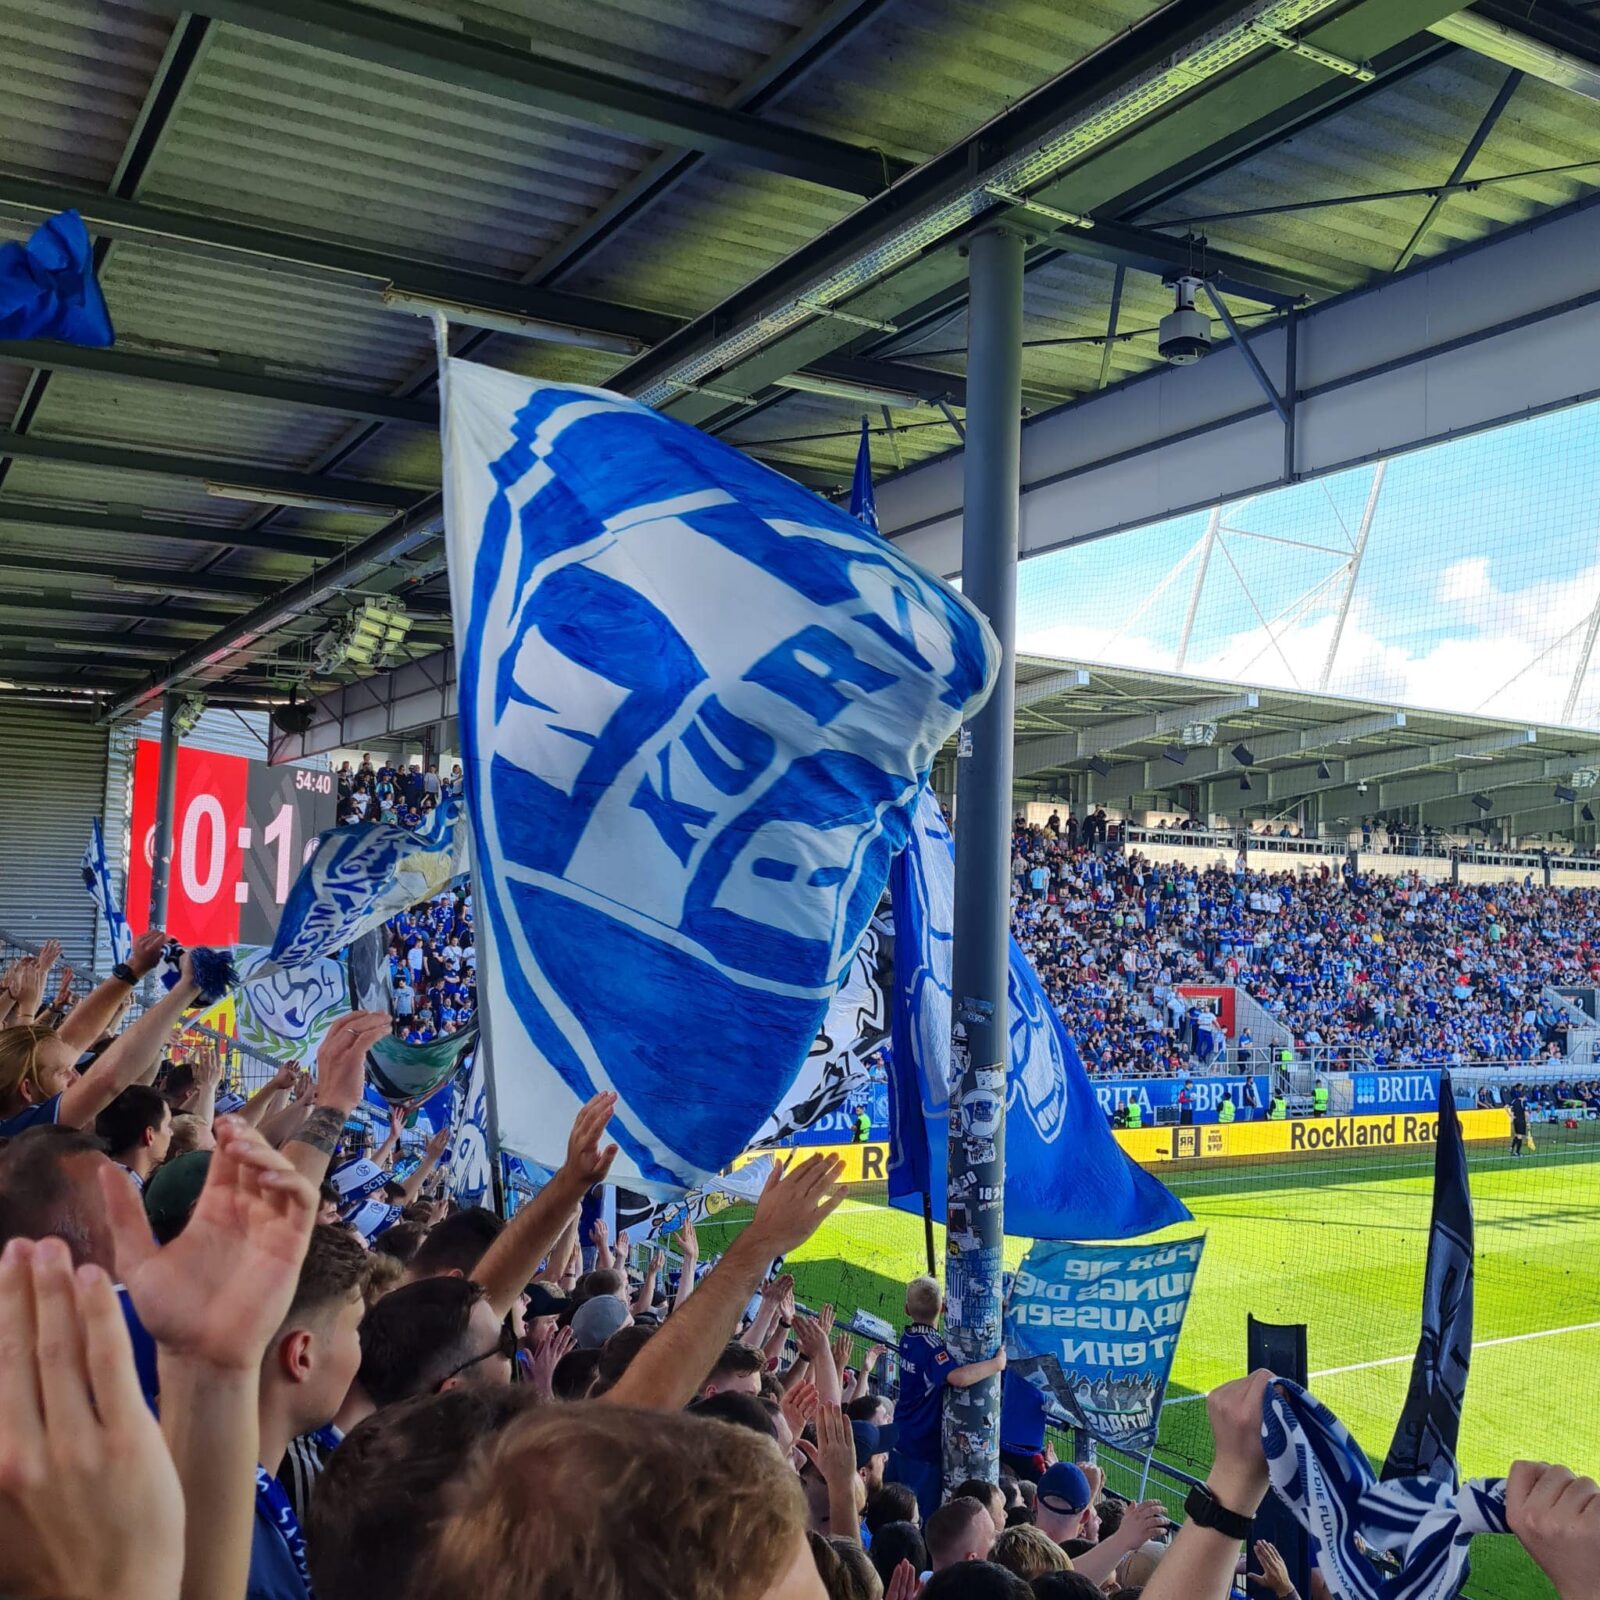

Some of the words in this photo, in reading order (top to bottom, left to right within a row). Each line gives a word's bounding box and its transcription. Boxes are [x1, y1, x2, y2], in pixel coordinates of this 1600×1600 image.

[295, 770, 332, 795] 54:40
[180, 792, 294, 905] 0:1
[1096, 1085, 1154, 1117] RITA
[1195, 1081, 1263, 1113] BRITA
[1377, 1075, 1437, 1104] BRITA
[1291, 1116, 1396, 1150] Rockland
